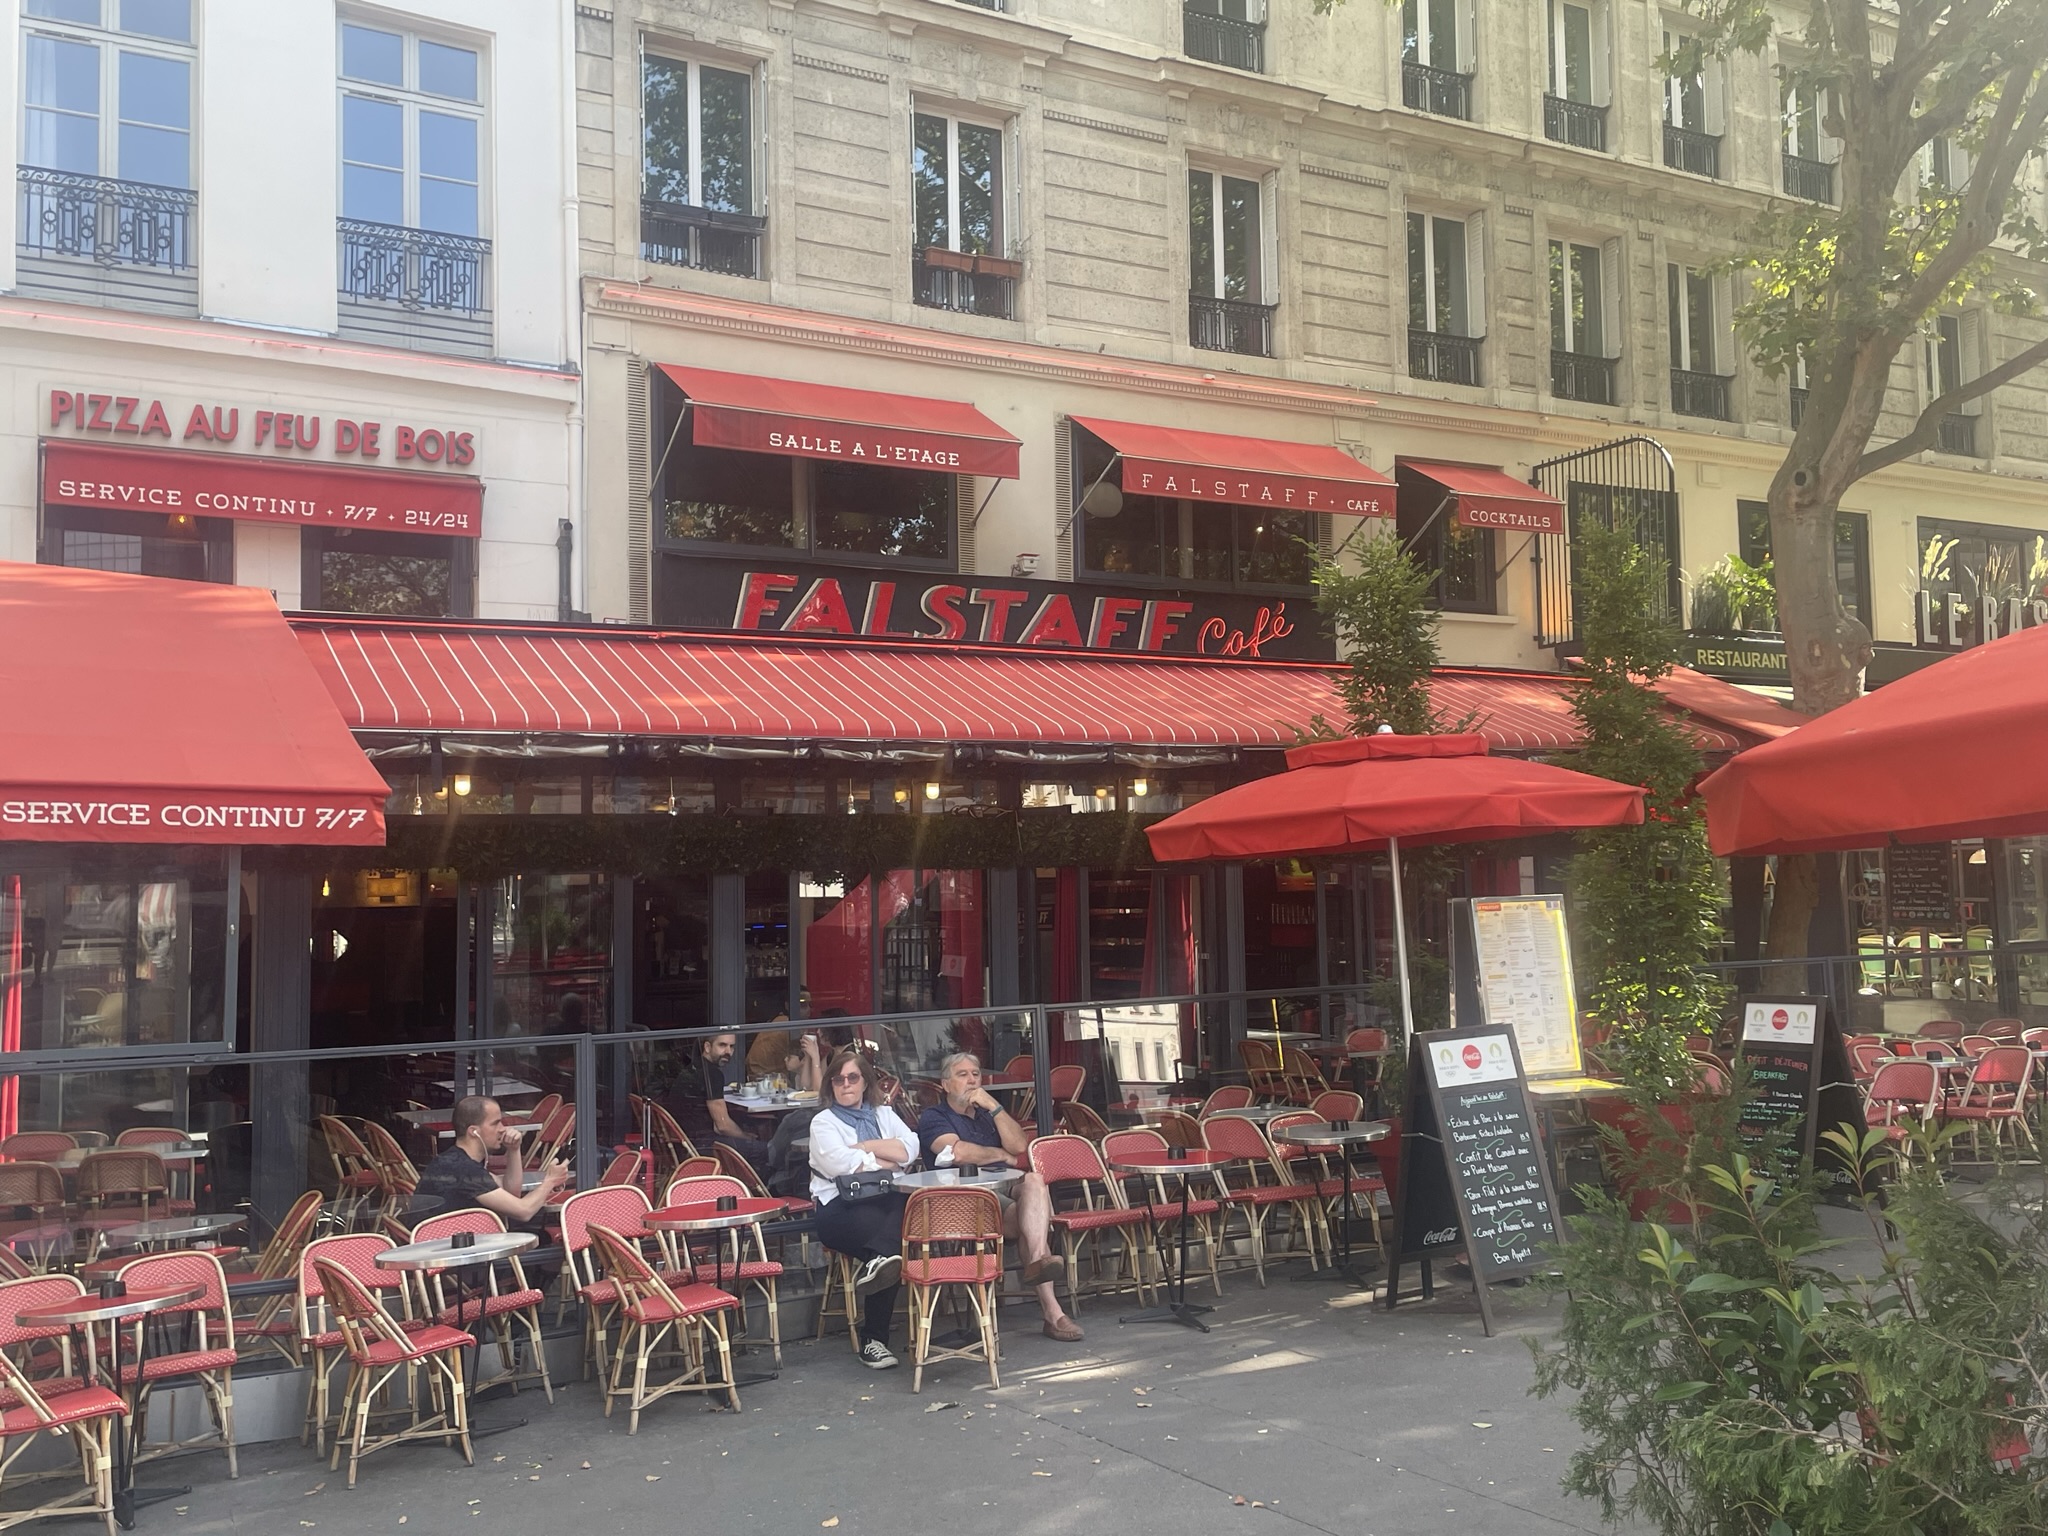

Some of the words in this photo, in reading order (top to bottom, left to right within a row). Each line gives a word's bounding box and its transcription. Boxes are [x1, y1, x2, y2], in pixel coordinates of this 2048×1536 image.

[51, 389, 172, 437] PIZZA
[184, 404, 239, 441] AU
[255, 410, 320, 450] FEU
[335, 418, 381, 457] DE
[396, 425, 476, 465] BOIS
[768, 432, 842, 453] SALLE
[851, 442, 866, 456] A
[875, 444, 960, 466] L'ETAGE
[1141, 473, 1319, 506] FALSTAFF
[1346, 498, 1380, 513] CAFÉ
[58, 480, 182, 506] SERVICE
[195, 492, 316, 517] CONTINU
[344, 505, 378, 521] 7/7
[405, 509, 469, 529] 24/24
[1469, 509, 1552, 528] COCKTAILS
[732, 571, 1193, 651] FALSTAFF
[1196, 600, 1295, 658] Café
[1919, 589, 1963, 646] LE
[1697, 649, 1788, 670] RESTAURANT
[2, 801, 151, 825] SERVICE
[160, 804, 306, 828] CONTINU
[315, 808, 368, 830] 7/7
[1753, 1070, 1789, 1080] BREAKFAST
[1472, 1114, 1480, 1125] de
[1459, 1151, 1482, 1164] Confit
[1484, 1148, 1493, 1160] de
[1462, 1169, 1471, 1177] sa
[1487, 1162, 1509, 1173] Maison
[1423, 1226, 1458, 1245] Coca-Cola
[1493, 1252, 1511, 1264] Bon
